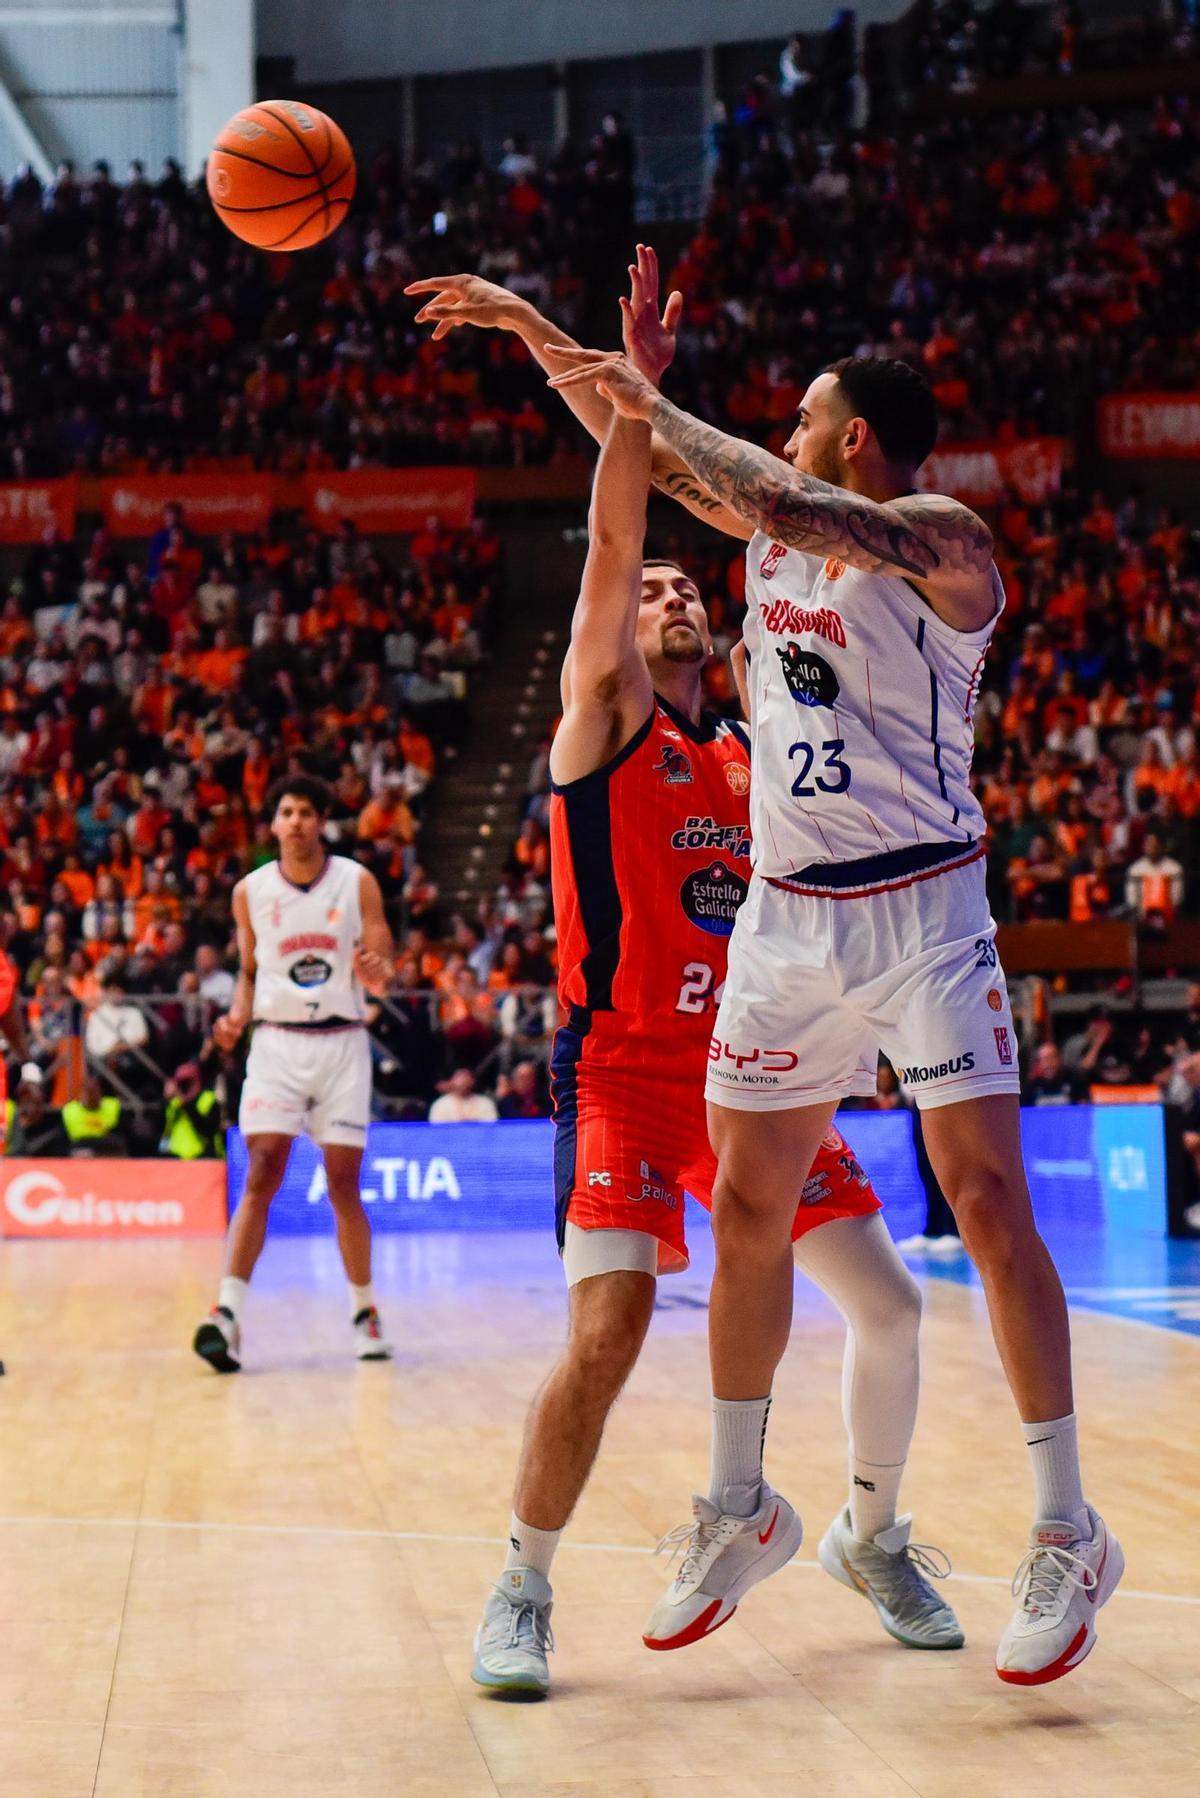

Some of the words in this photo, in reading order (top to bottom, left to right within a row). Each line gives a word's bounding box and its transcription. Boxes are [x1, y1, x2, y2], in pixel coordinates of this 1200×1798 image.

[788, 738, 851, 797] 23
[692, 881, 741, 901] Estrella
[695, 898, 737, 918] Galicia
[675, 961, 726, 1014] 2
[709, 1037, 799, 1072] BYD
[741, 1074, 779, 1084] MOTOR
[308, 1157, 462, 1204] TIA
